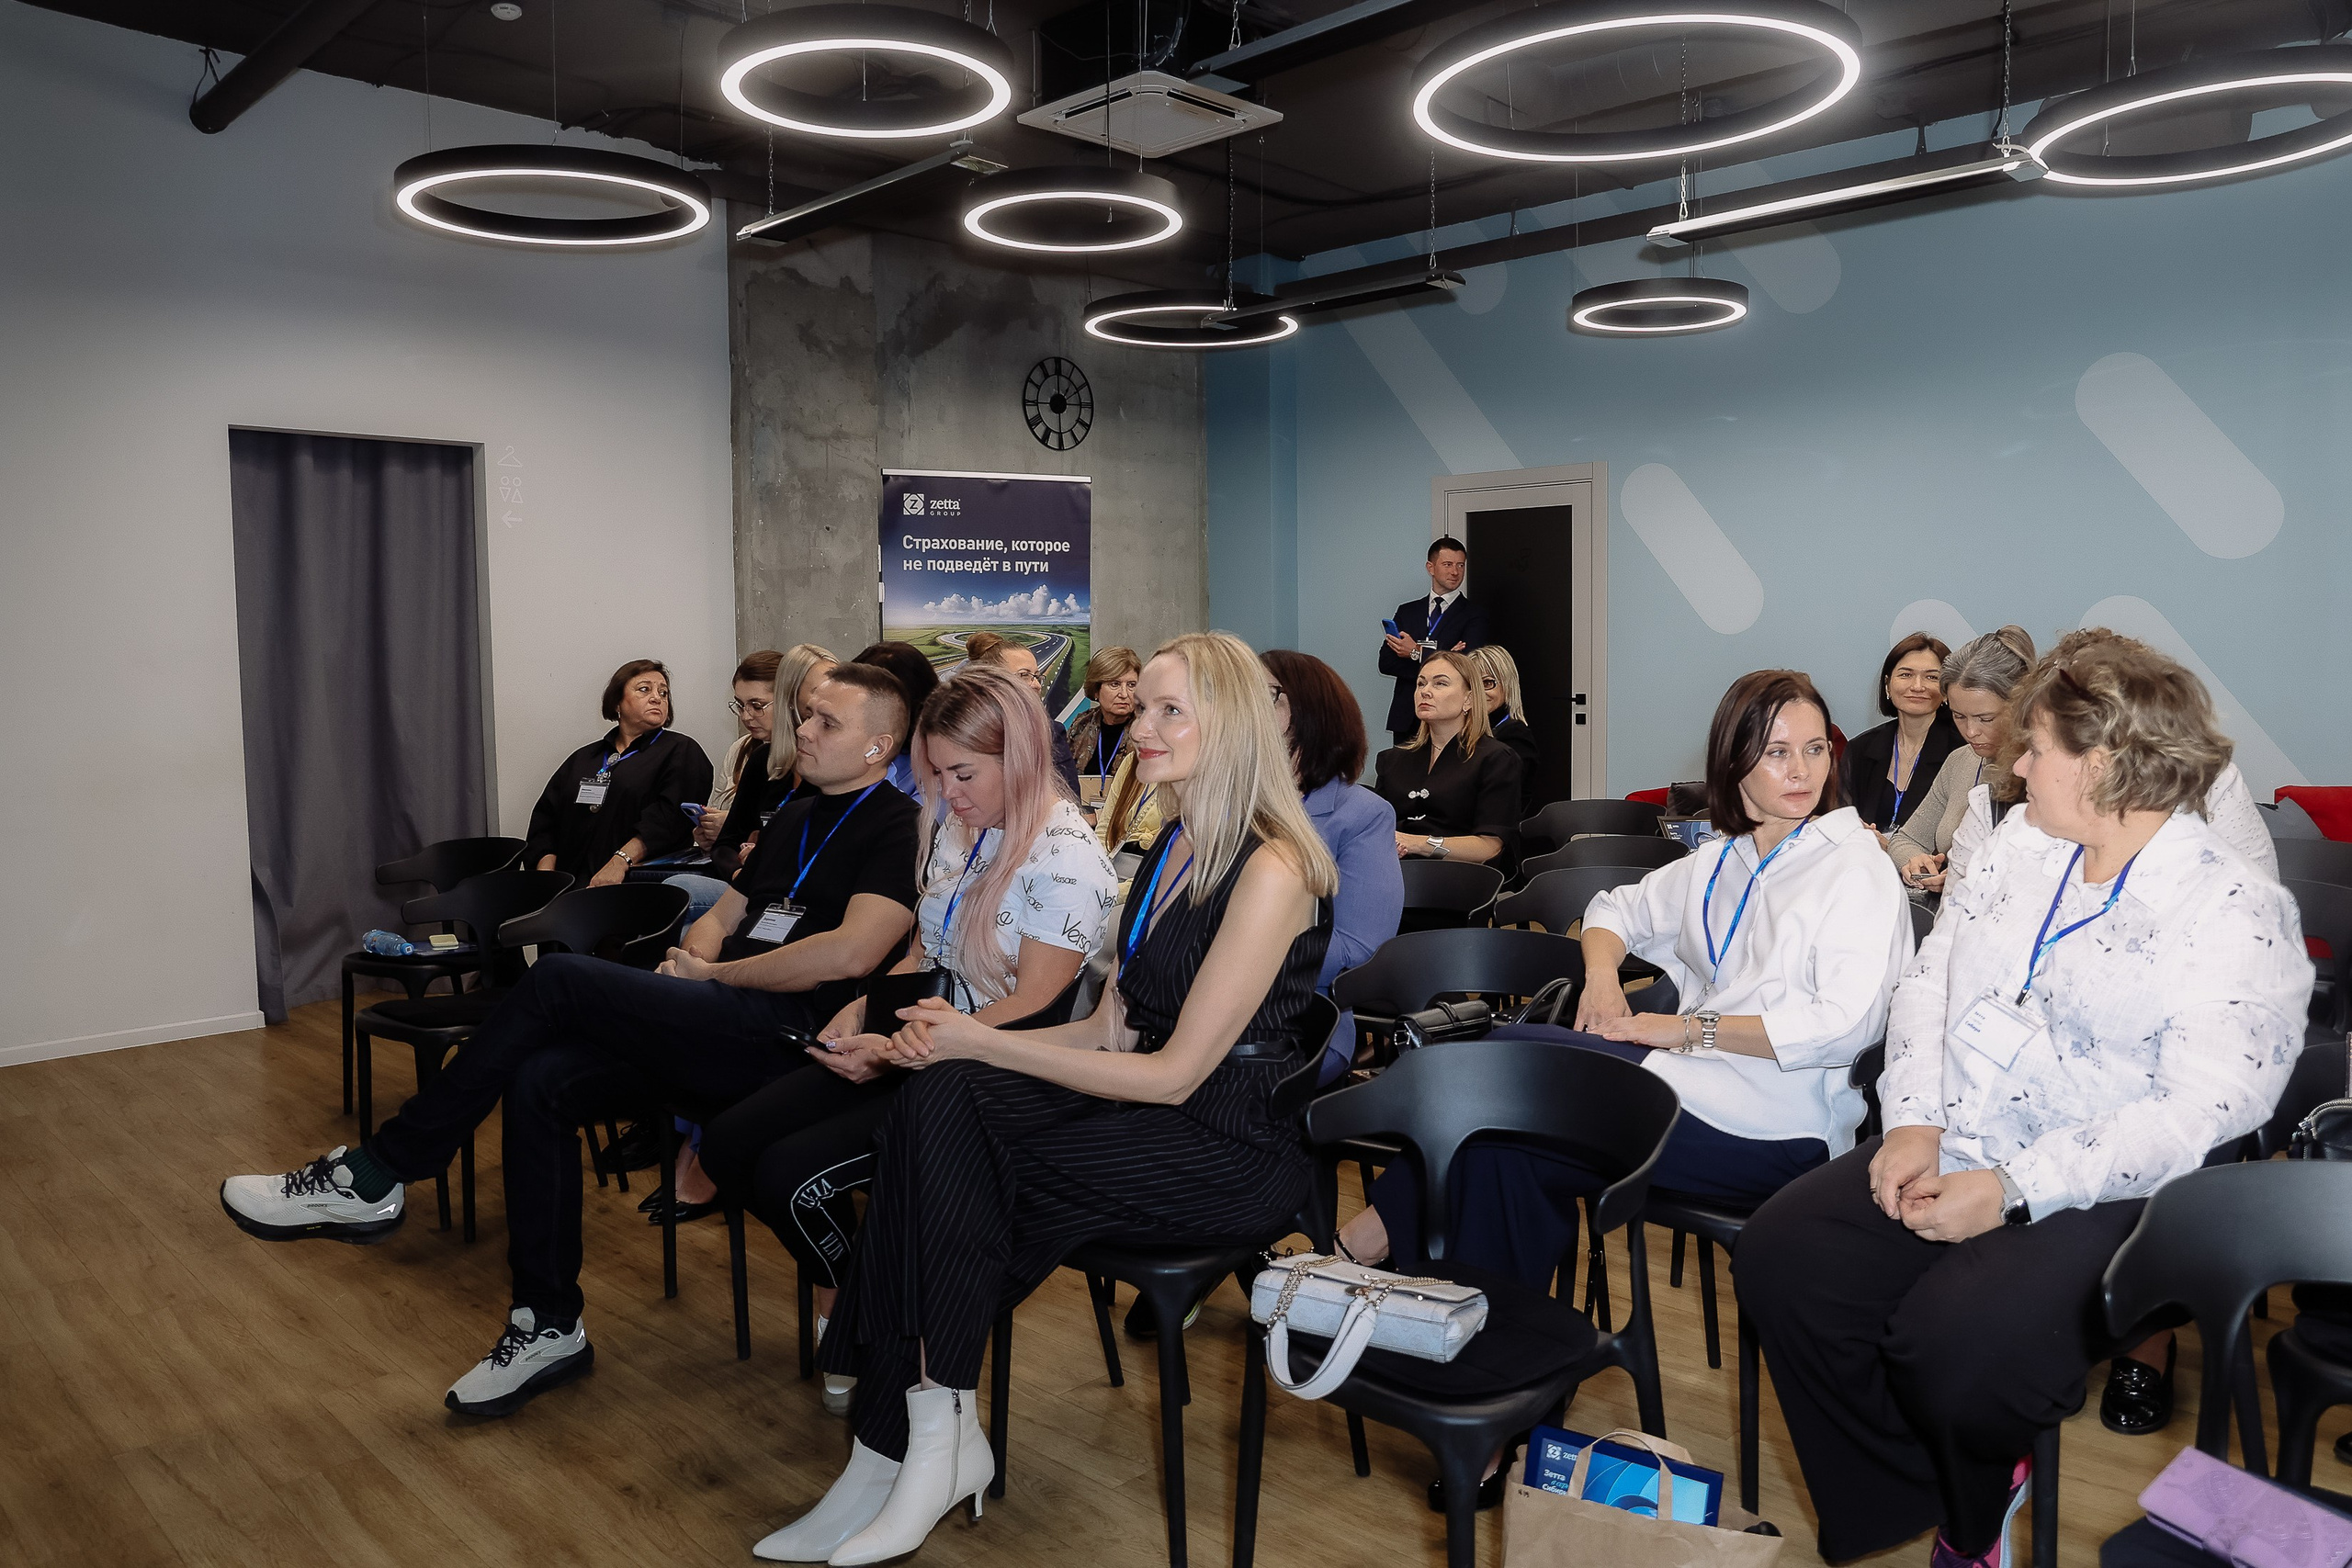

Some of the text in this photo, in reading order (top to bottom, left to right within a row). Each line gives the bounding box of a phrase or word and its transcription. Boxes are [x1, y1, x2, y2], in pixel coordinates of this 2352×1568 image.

[930, 499, 961, 510] zetta
[902, 535, 1071, 555] Страхование, которое
[903, 557, 1049, 576] не подведёт в пути
[1544, 1469, 1566, 1482] Зетта
